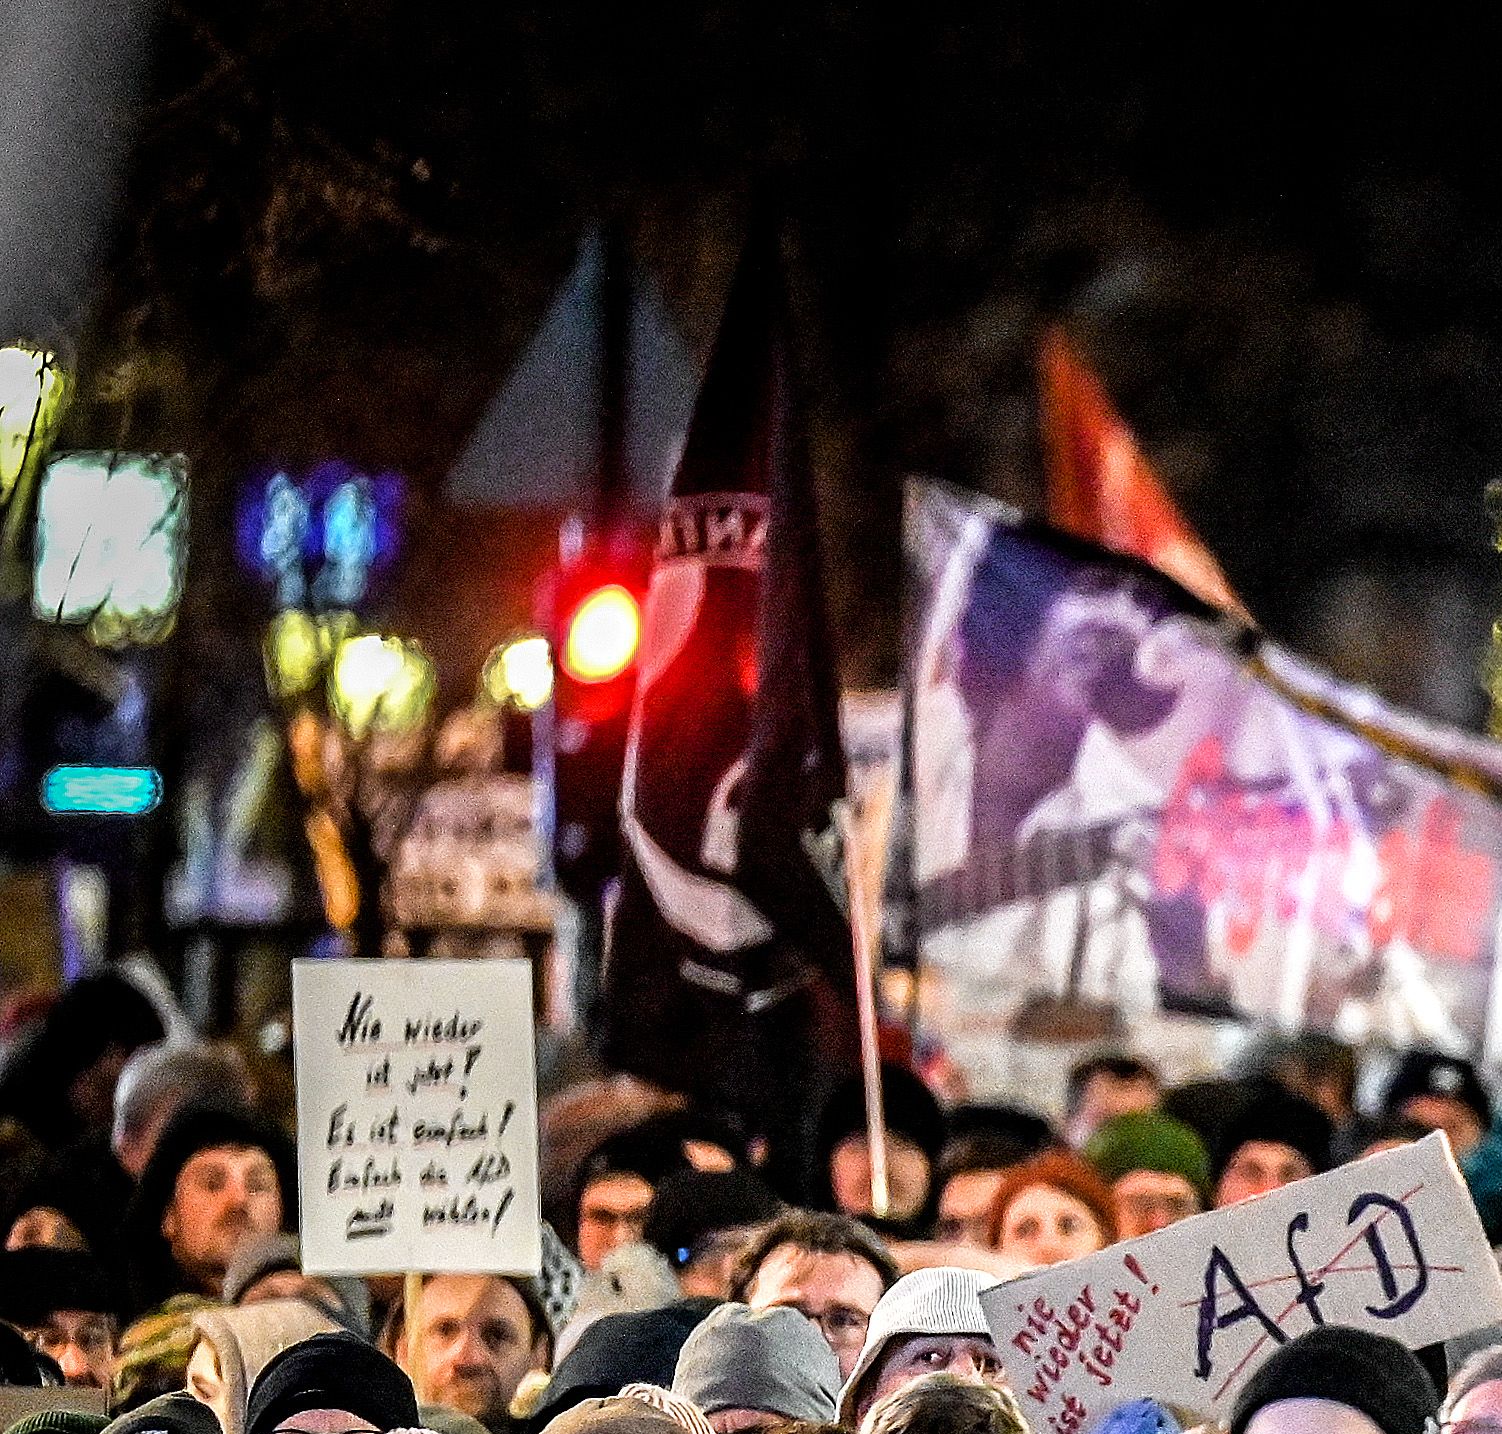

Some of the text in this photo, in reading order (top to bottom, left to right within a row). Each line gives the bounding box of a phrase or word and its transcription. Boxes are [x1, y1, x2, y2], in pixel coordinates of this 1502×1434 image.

[336, 991, 486, 1046] Nie wieder
[366, 1053, 390, 1085] ist
[326, 1102, 357, 1148] Es
[369, 1104, 399, 1145] ist
[1192, 1191, 1428, 1381] AfD
[1011, 1296, 1056, 1356] nie
[1026, 1284, 1098, 1404] wieder
